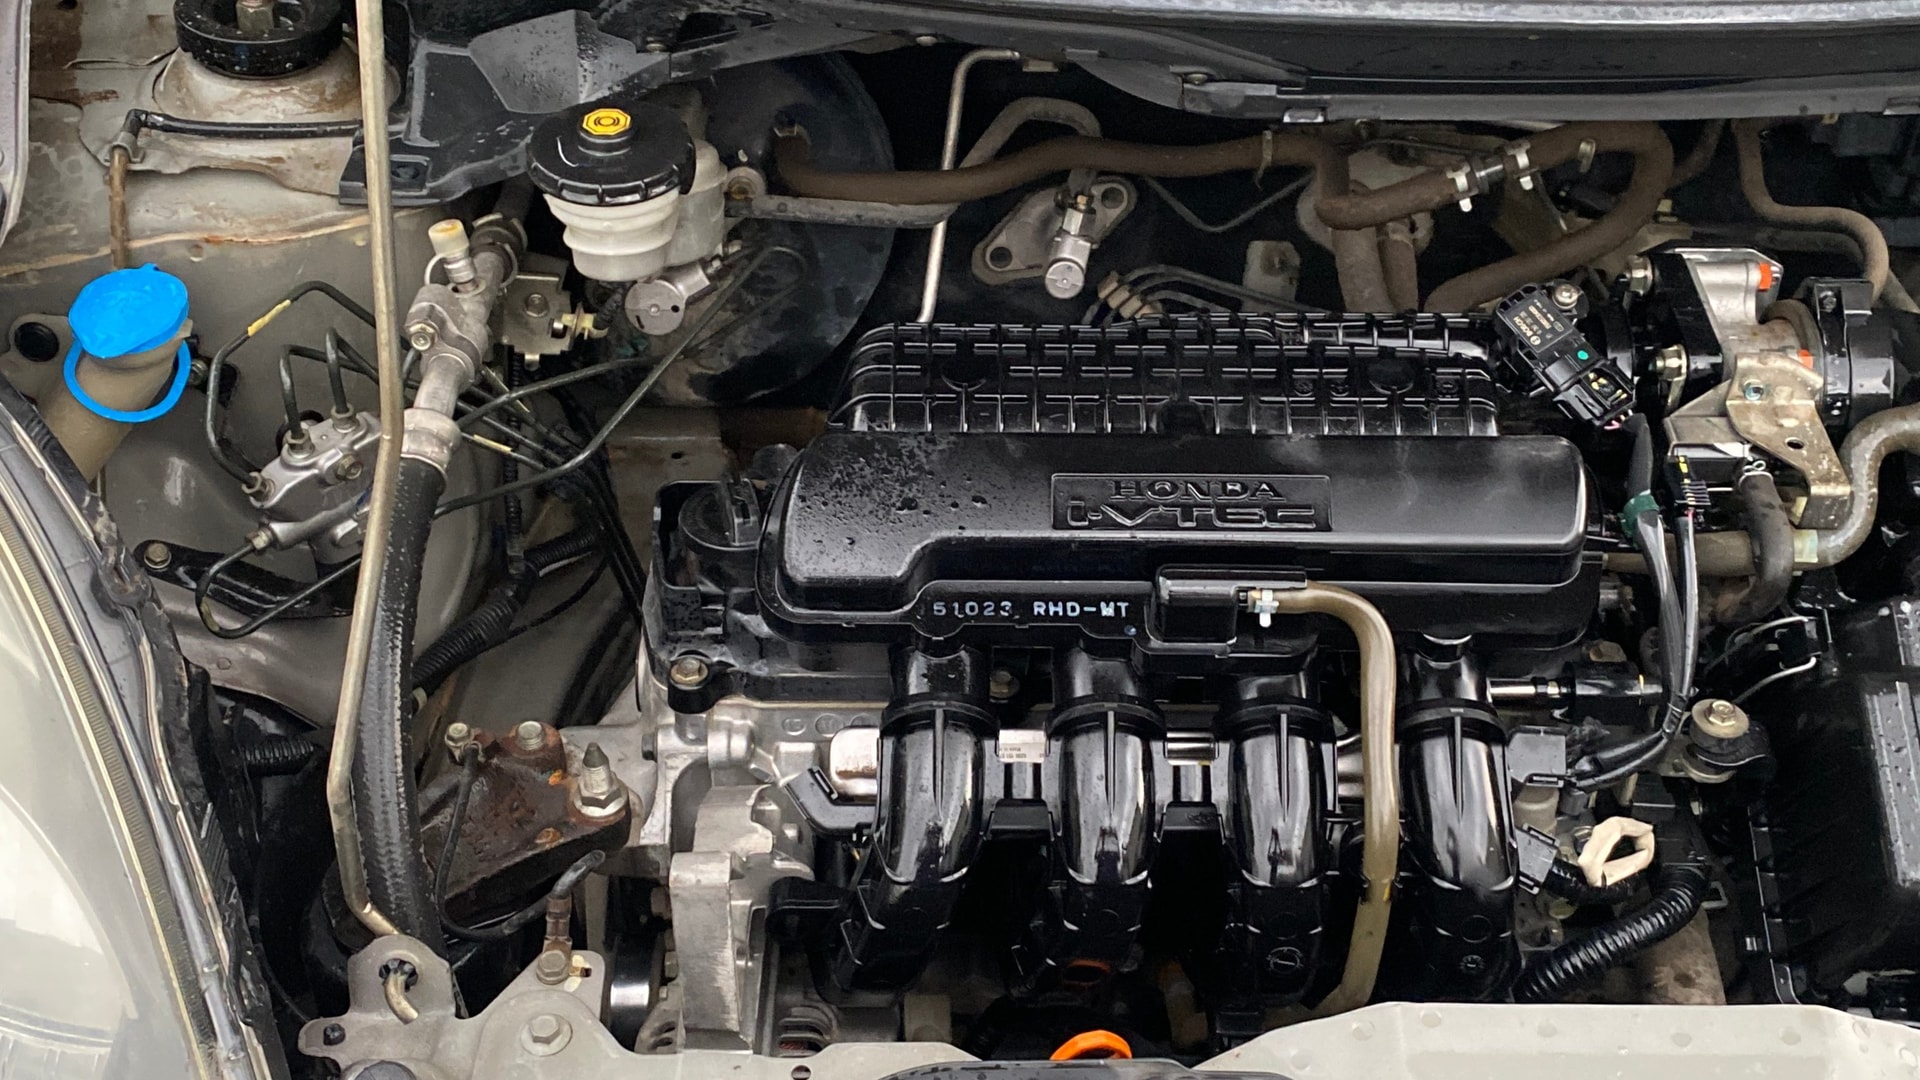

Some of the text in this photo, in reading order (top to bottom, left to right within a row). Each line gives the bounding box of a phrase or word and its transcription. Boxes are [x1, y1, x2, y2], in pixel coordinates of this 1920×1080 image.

[1110, 480, 1286, 501] HONDA
[933, 601, 1129, 618] 51023 RHD-MT
